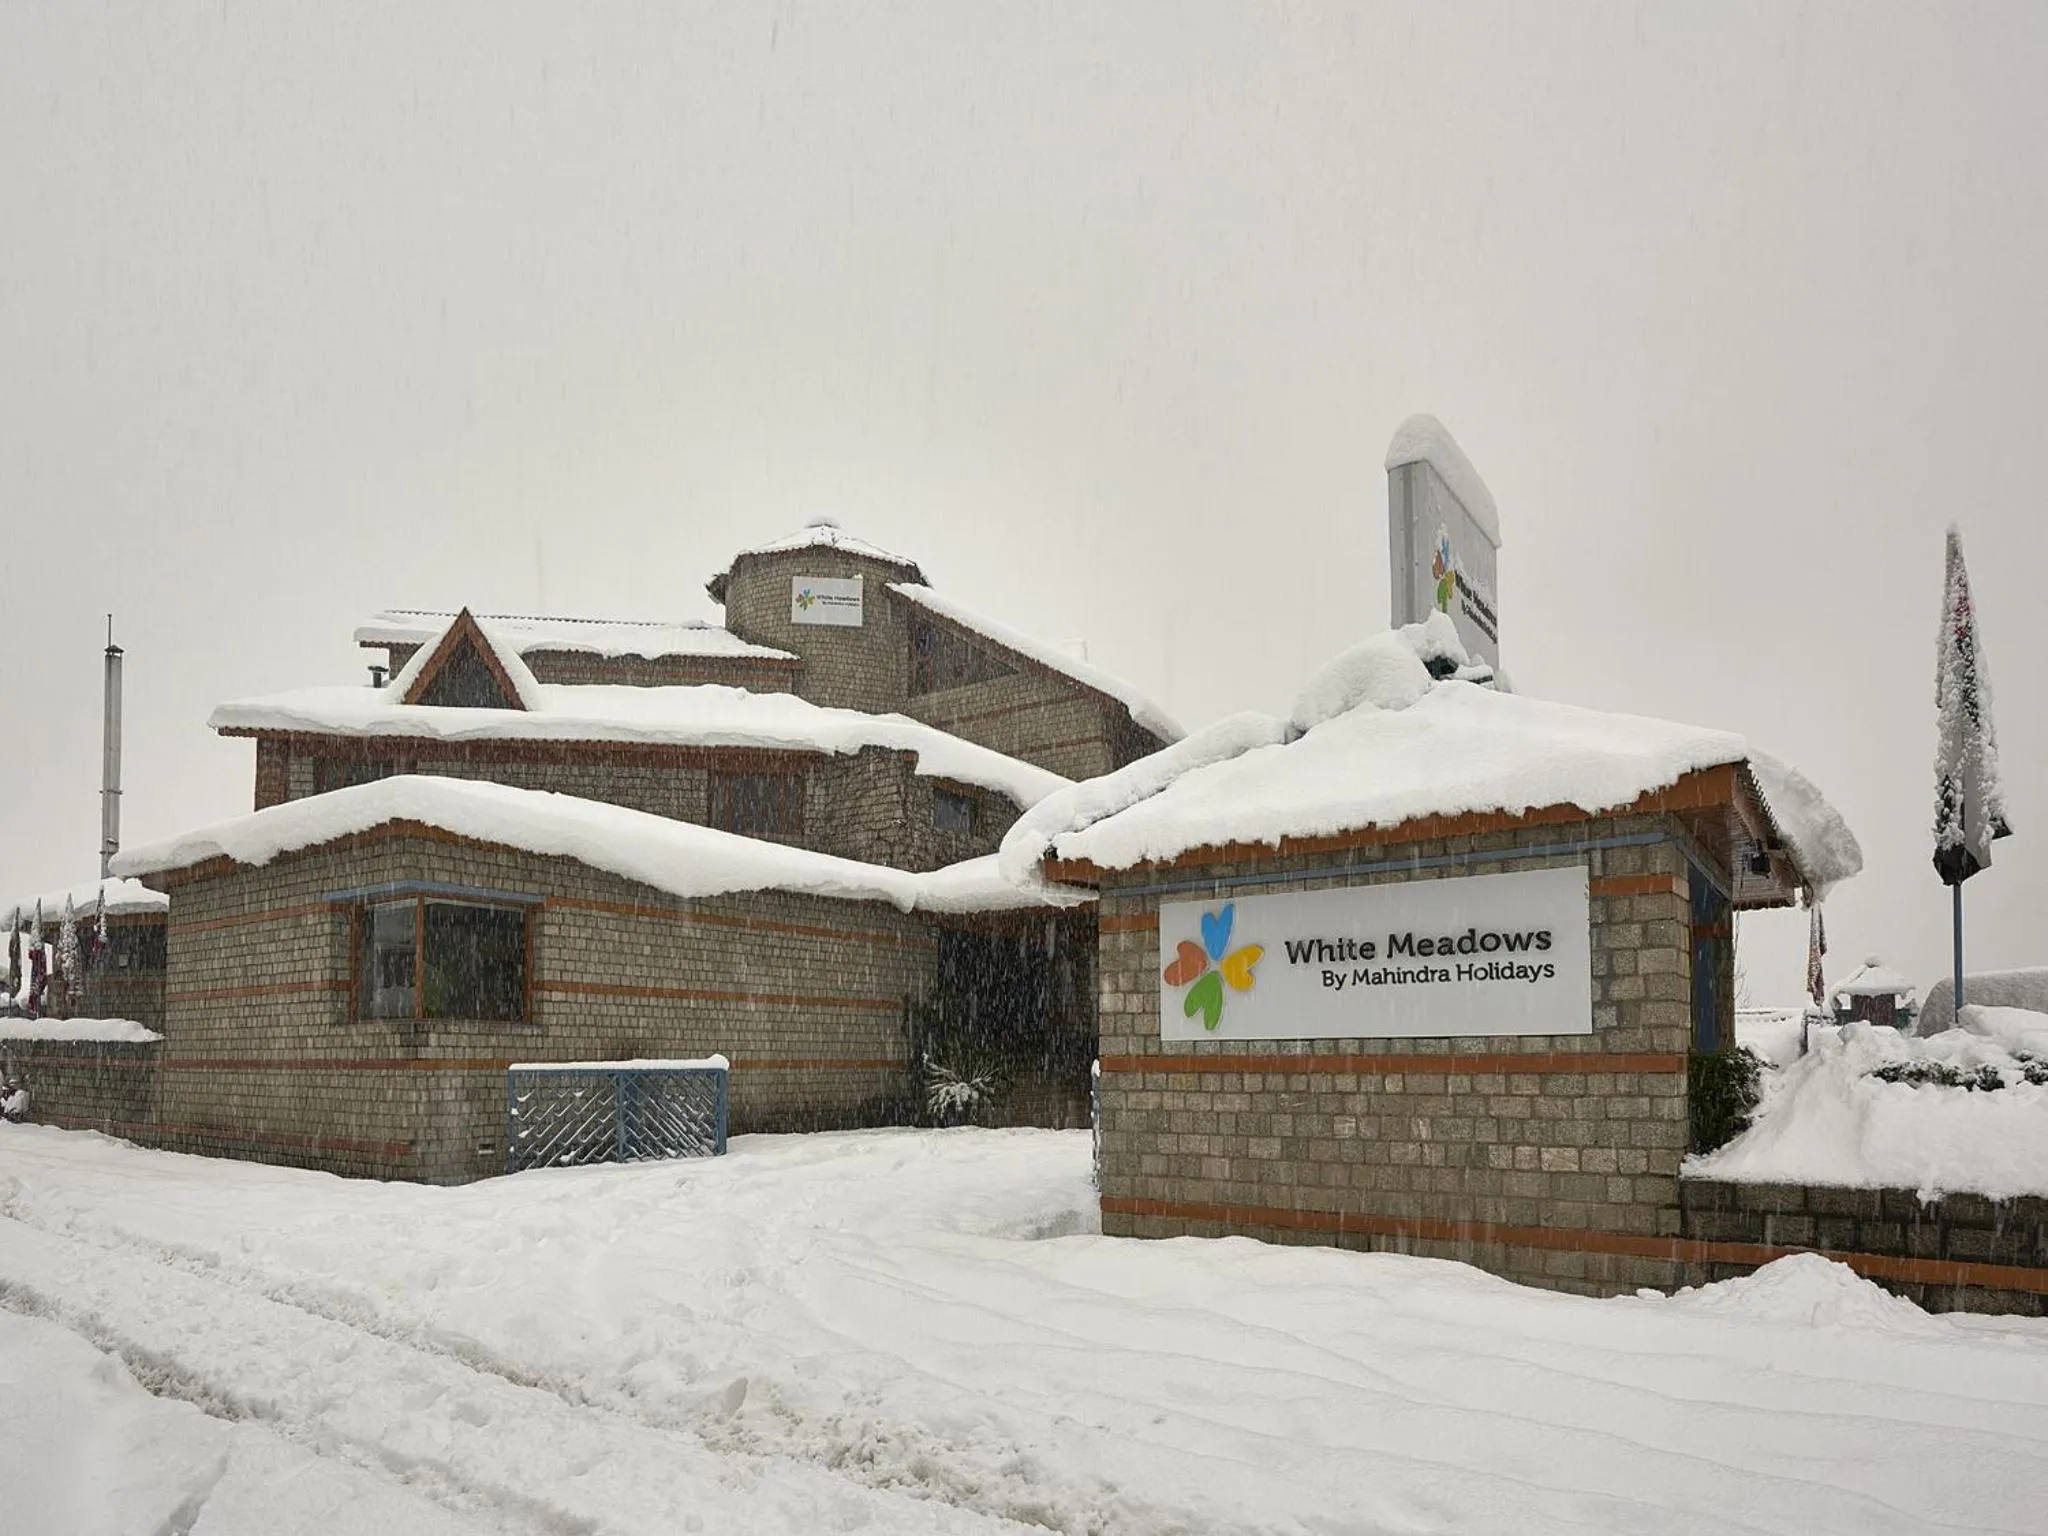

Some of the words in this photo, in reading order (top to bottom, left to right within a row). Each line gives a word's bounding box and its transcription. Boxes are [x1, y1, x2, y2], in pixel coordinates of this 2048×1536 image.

[1284, 937, 1376, 964] White
[1386, 928, 1552, 959] Meadows
[1321, 969, 1347, 991] By
[1351, 965, 1451, 986] Mahindra
[1456, 961, 1555, 983] Holidays
